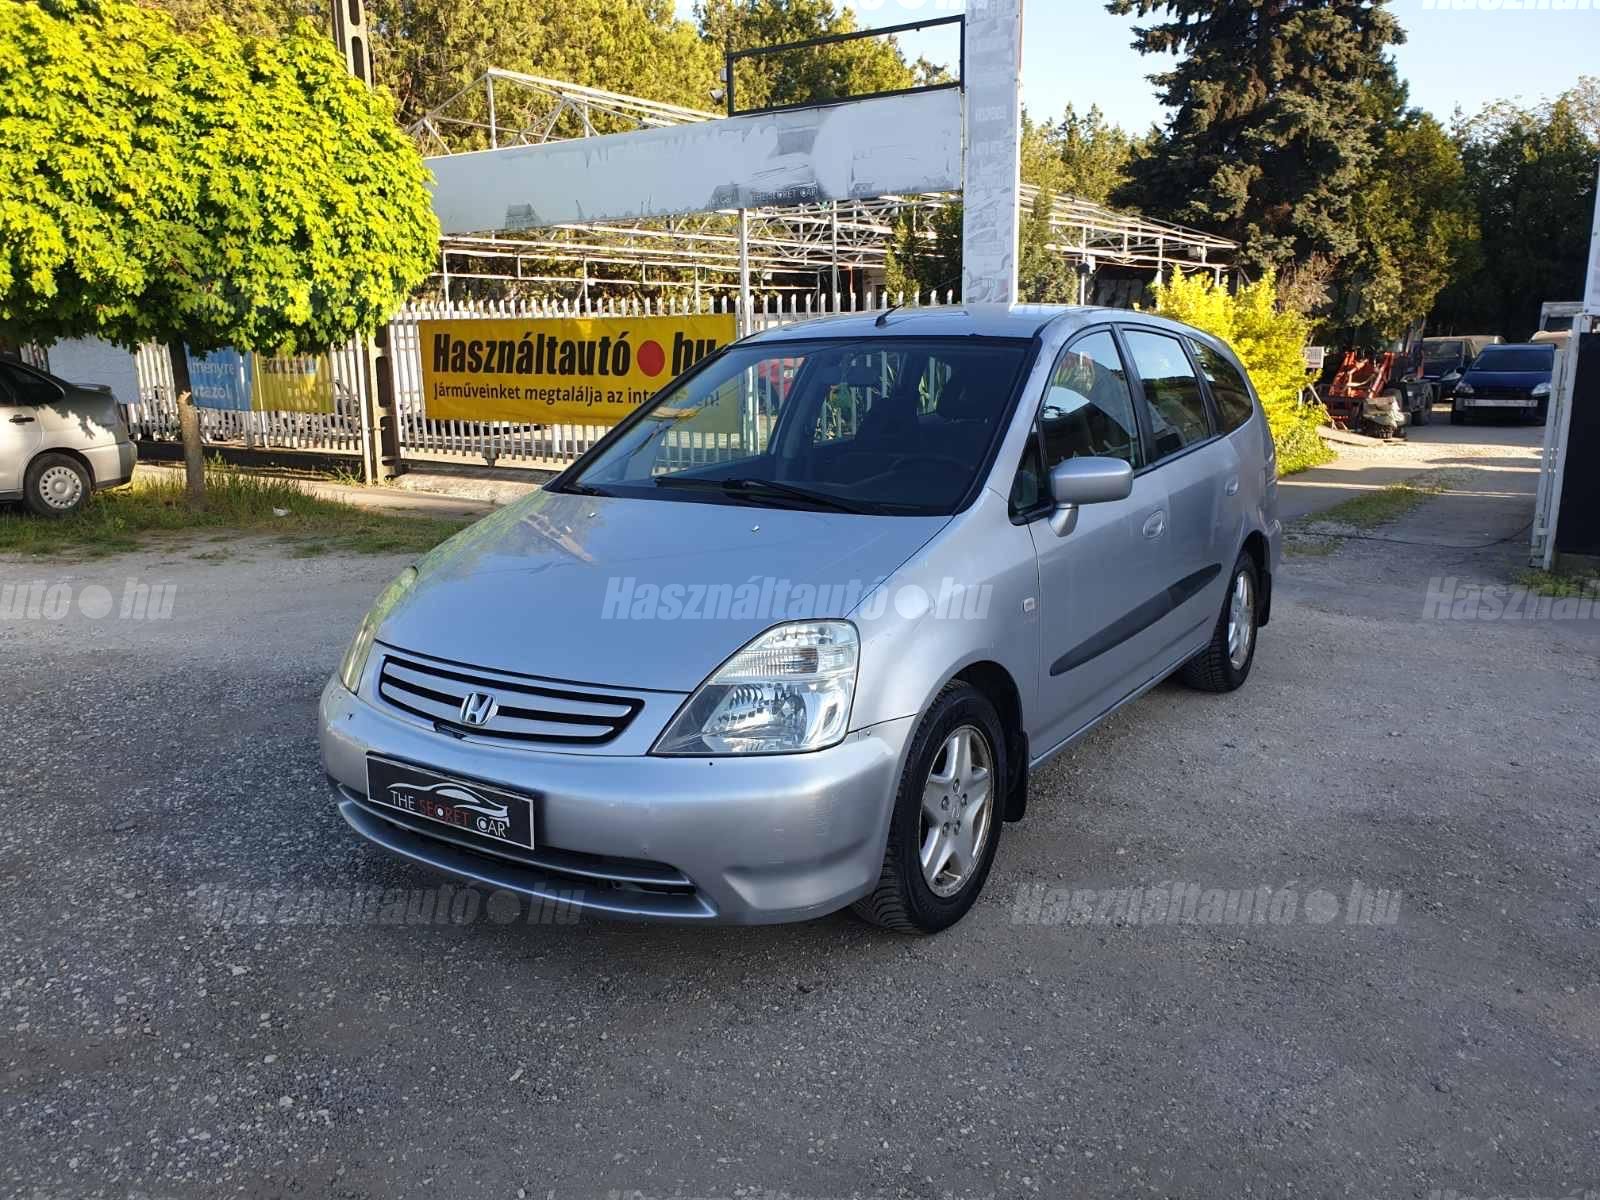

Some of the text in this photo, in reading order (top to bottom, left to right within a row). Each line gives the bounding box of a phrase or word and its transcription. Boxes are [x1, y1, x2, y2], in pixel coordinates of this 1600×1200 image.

[433, 331, 631, 376] Használtautó
[433, 381, 521, 400] Járműveinket
[524, 384, 603, 407] megtalálja
[607, 390, 623, 404] az
[390, 789, 416, 811] THE
[476, 816, 506, 838] CAR
